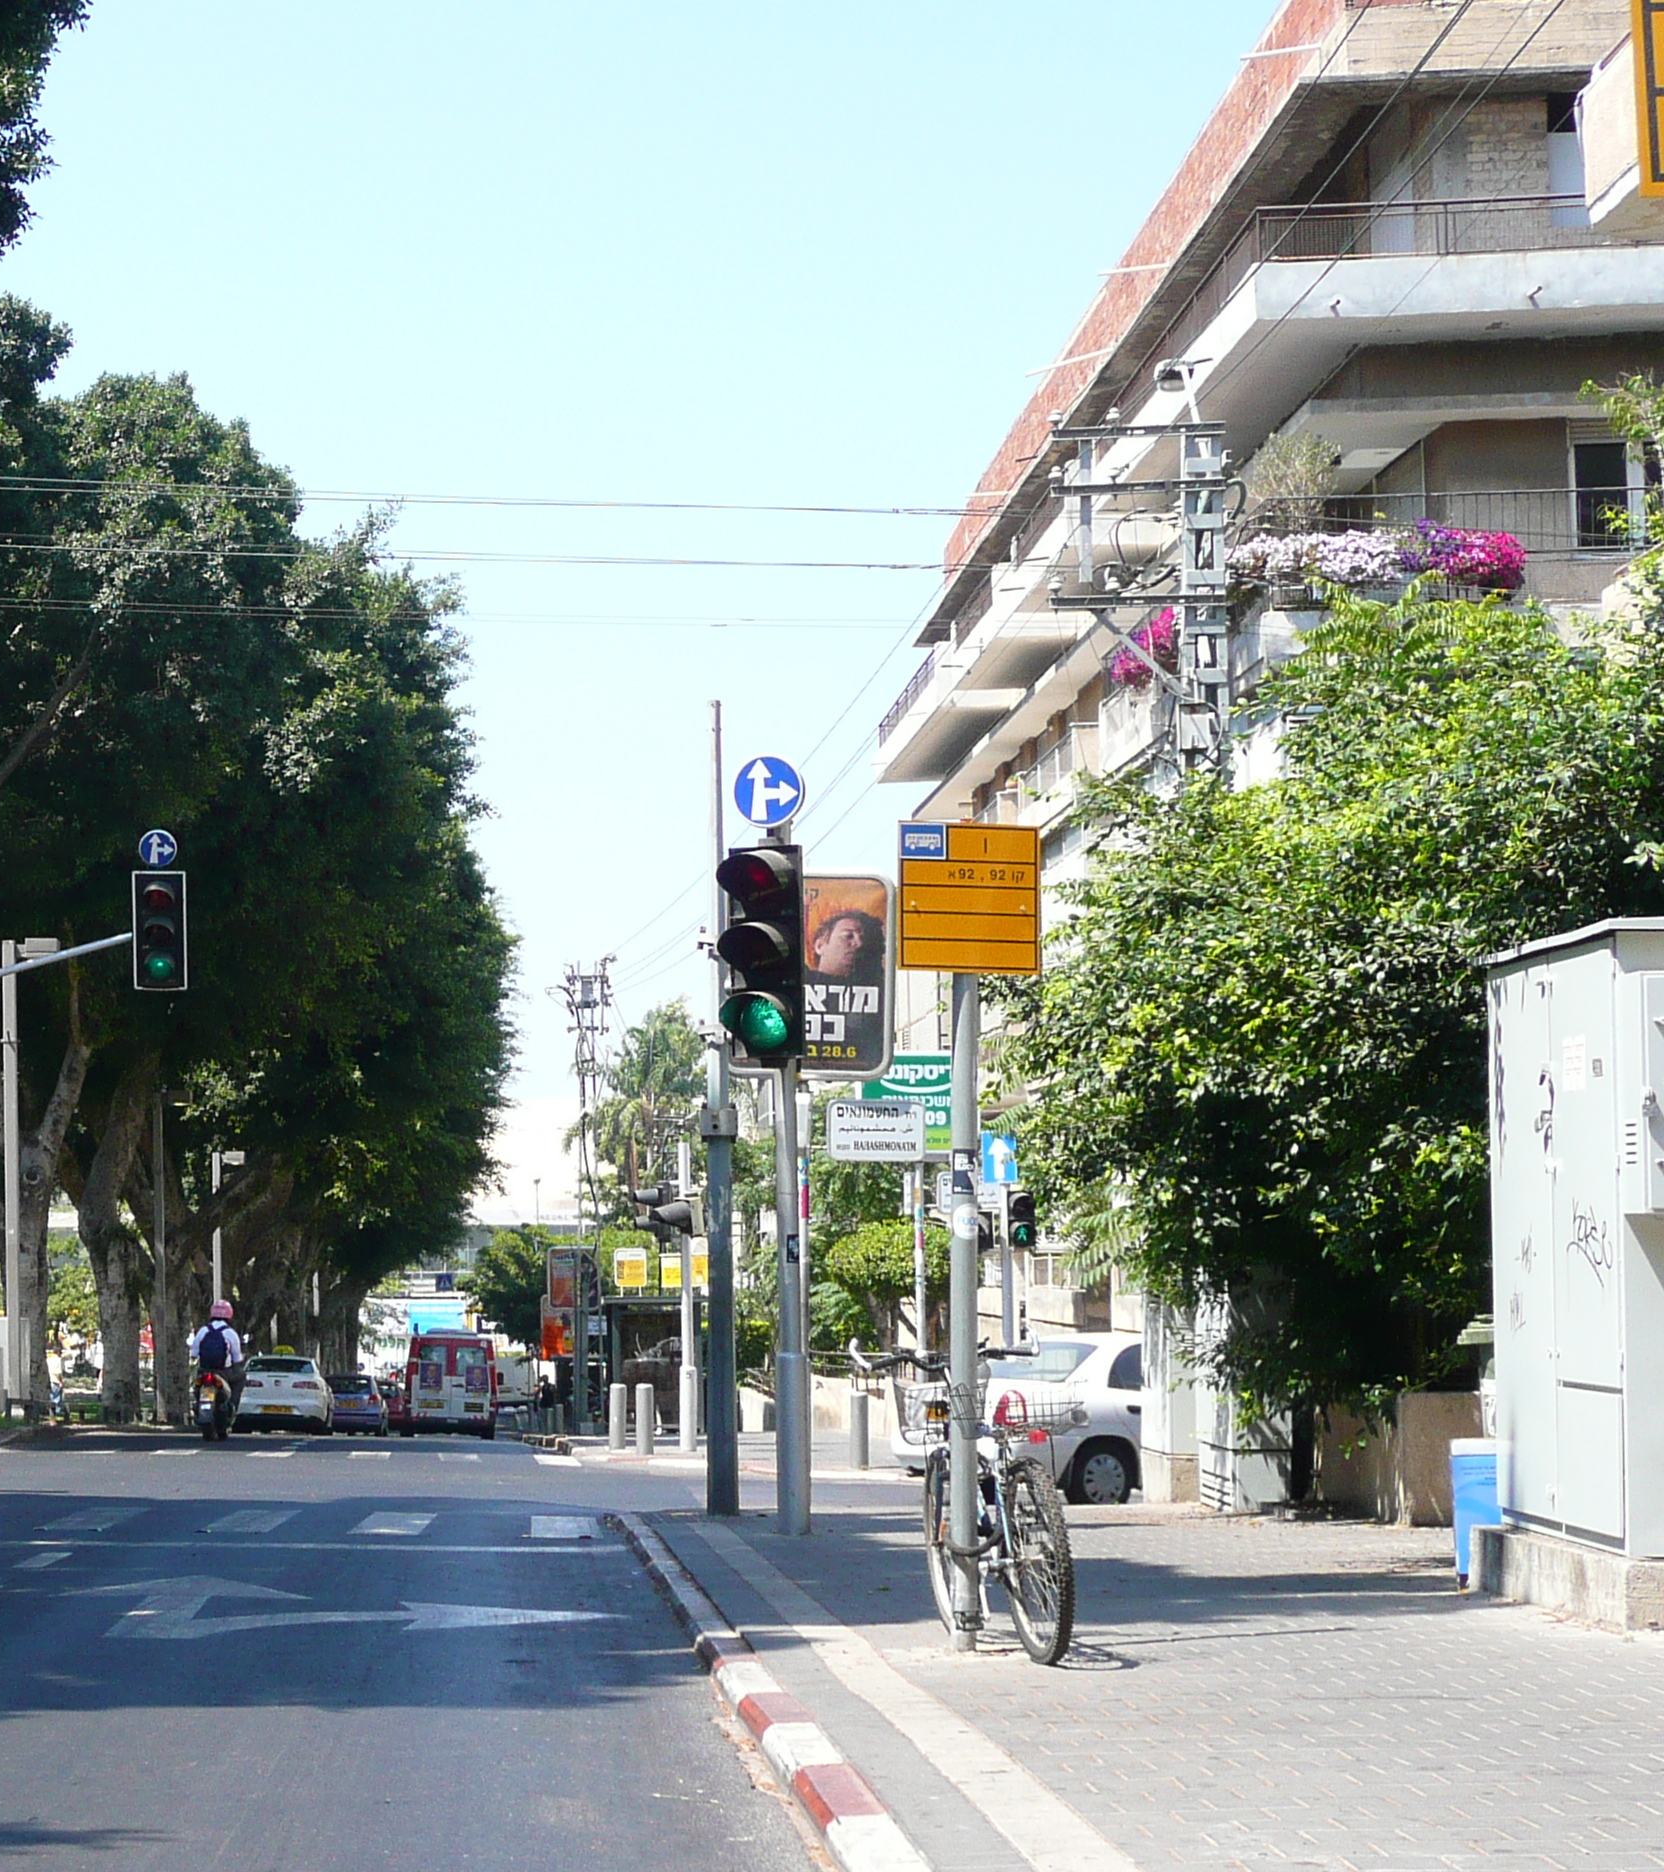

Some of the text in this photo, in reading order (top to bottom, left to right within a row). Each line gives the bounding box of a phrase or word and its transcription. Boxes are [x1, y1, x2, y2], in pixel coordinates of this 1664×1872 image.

[989, 869, 1006, 881] 92
[821, 1045, 857, 1058] 28.6
[836, 1105, 899, 1119] החשמונאים
